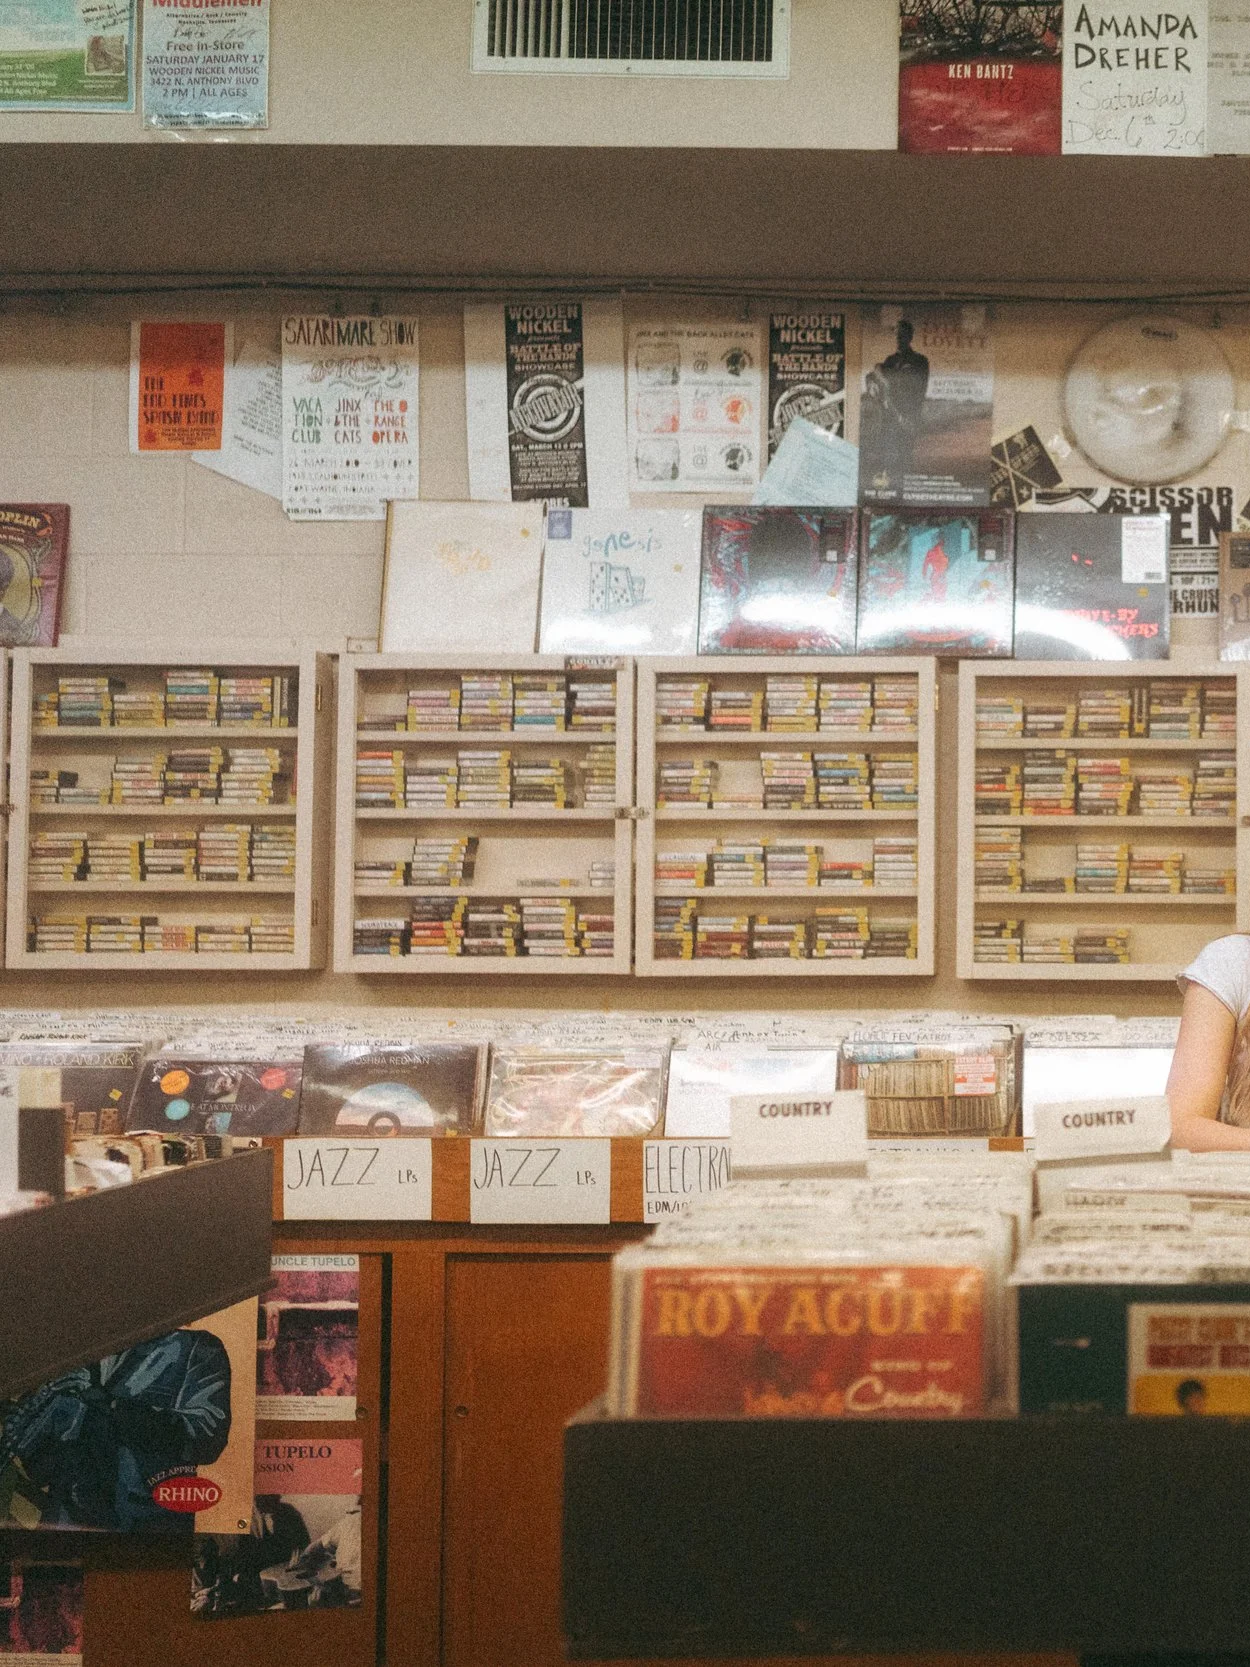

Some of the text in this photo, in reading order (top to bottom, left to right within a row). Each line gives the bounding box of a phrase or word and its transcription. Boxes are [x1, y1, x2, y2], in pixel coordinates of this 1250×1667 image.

[1075, 4, 1198, 40] AMANDA
[166, 41, 192, 52] Free
[146, 53, 265, 65] SATURDAY JANUARY 17
[1075, 43, 1191, 73] DREHER
[148, 66, 260, 76] WOODEN NICKEL MUSIC
[949, 65, 1014, 79] KEN BANTZ
[187, 77, 232, 86] ANTHONY
[235, 77, 259, 85] BLVD
[162, 88, 248, 97] 2 PM ALL AGES
[1077, 81, 1186, 127] Saturday
[1066, 120, 1120, 146] Dec.
[509, 306, 578, 320] WOODEN
[517, 320, 572, 334] NICKEL
[773, 316, 841, 328] WOODEN
[379, 321, 417, 347] SHOW
[780, 329, 834, 344] NICKEL
[514, 363, 575, 371] SHOWCASE
[776, 373, 838, 381] SHOWCASE
[335, 398, 361, 413] JINX
[374, 400, 394, 413] THE
[291, 429, 321, 444] CLUB
[334, 430, 362, 444] CATS
[372, 431, 408, 444] OPERA
[1109, 487, 1233, 508] SCISSOR
[1172, 601, 1220, 613] RHUN
[47, 1053, 101, 1066] ROLAND
[103, 1052, 135, 1066] KIRK
[389, 1056, 430, 1065] REDMAN
[759, 1101, 832, 1119] COUNTRY
[1062, 1109, 1136, 1128] COUNTRY
[287, 1148, 418, 1190] JAZZ LPs
[473, 1147, 596, 1189] JAZZ LPs
[271, 1256, 356, 1267] UNCLE TUPELO
[655, 1288, 769, 1338] ROY
[845, 1375, 963, 1415] Country
[263, 1446, 332, 1459] TUPELO
[147, 1471, 167, 1487] JAZZ
[159, 1487, 219, 1502] RHINO
